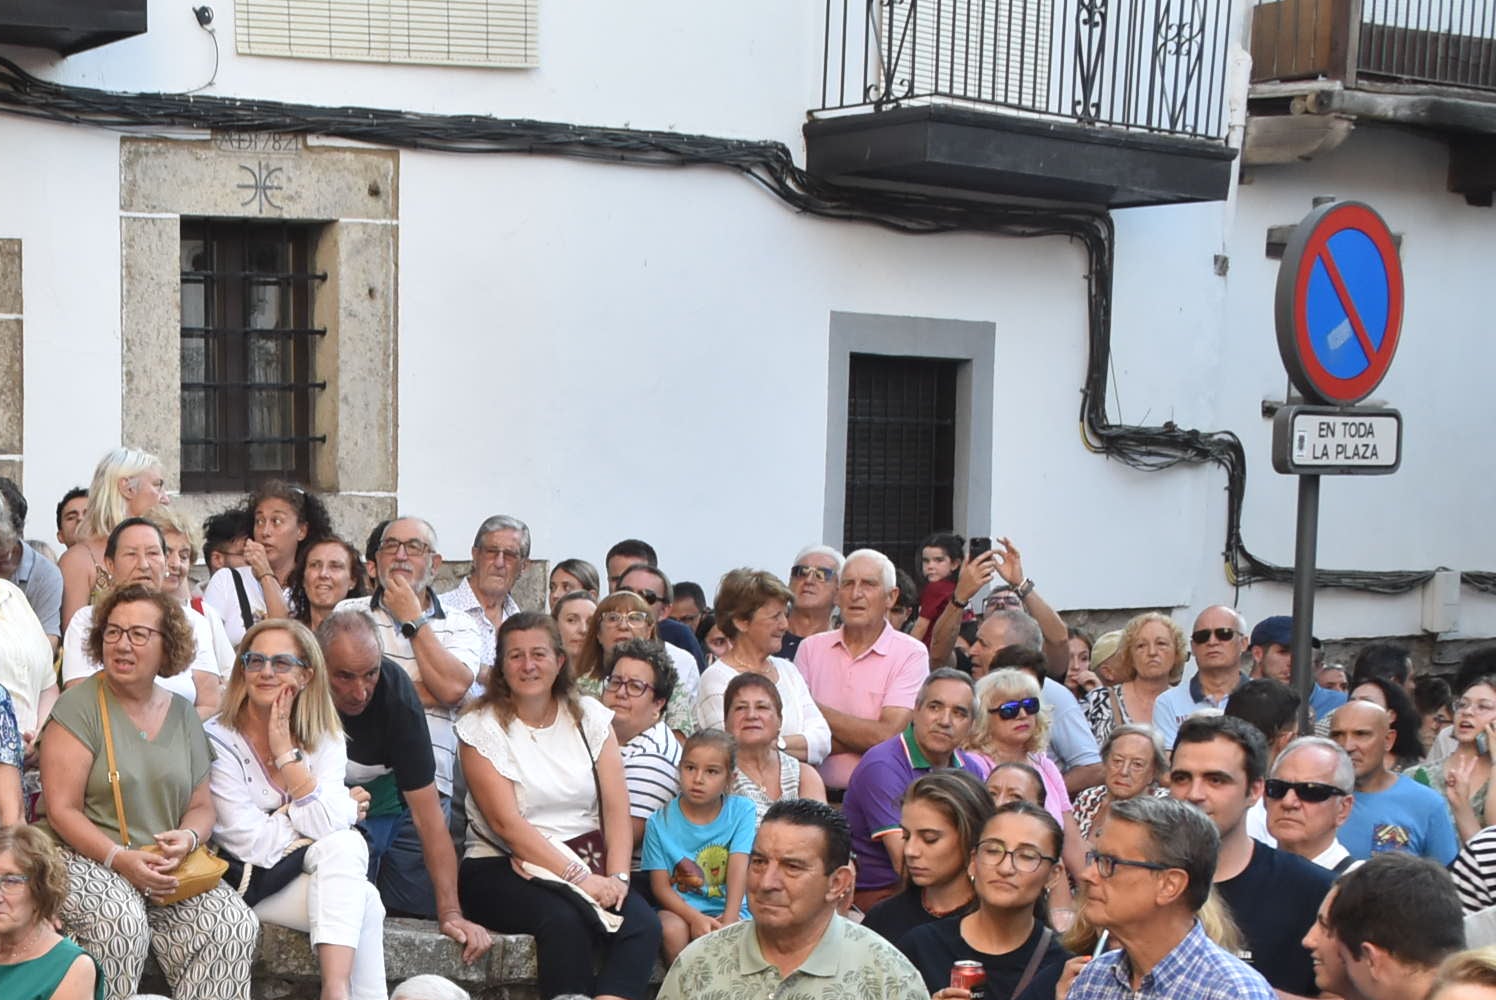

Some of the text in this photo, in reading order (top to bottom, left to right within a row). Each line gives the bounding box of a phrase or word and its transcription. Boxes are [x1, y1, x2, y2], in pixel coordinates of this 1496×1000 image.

[1318, 422, 1375, 438] EN TODA
[1312, 444, 1379, 460] LA PLAZA
